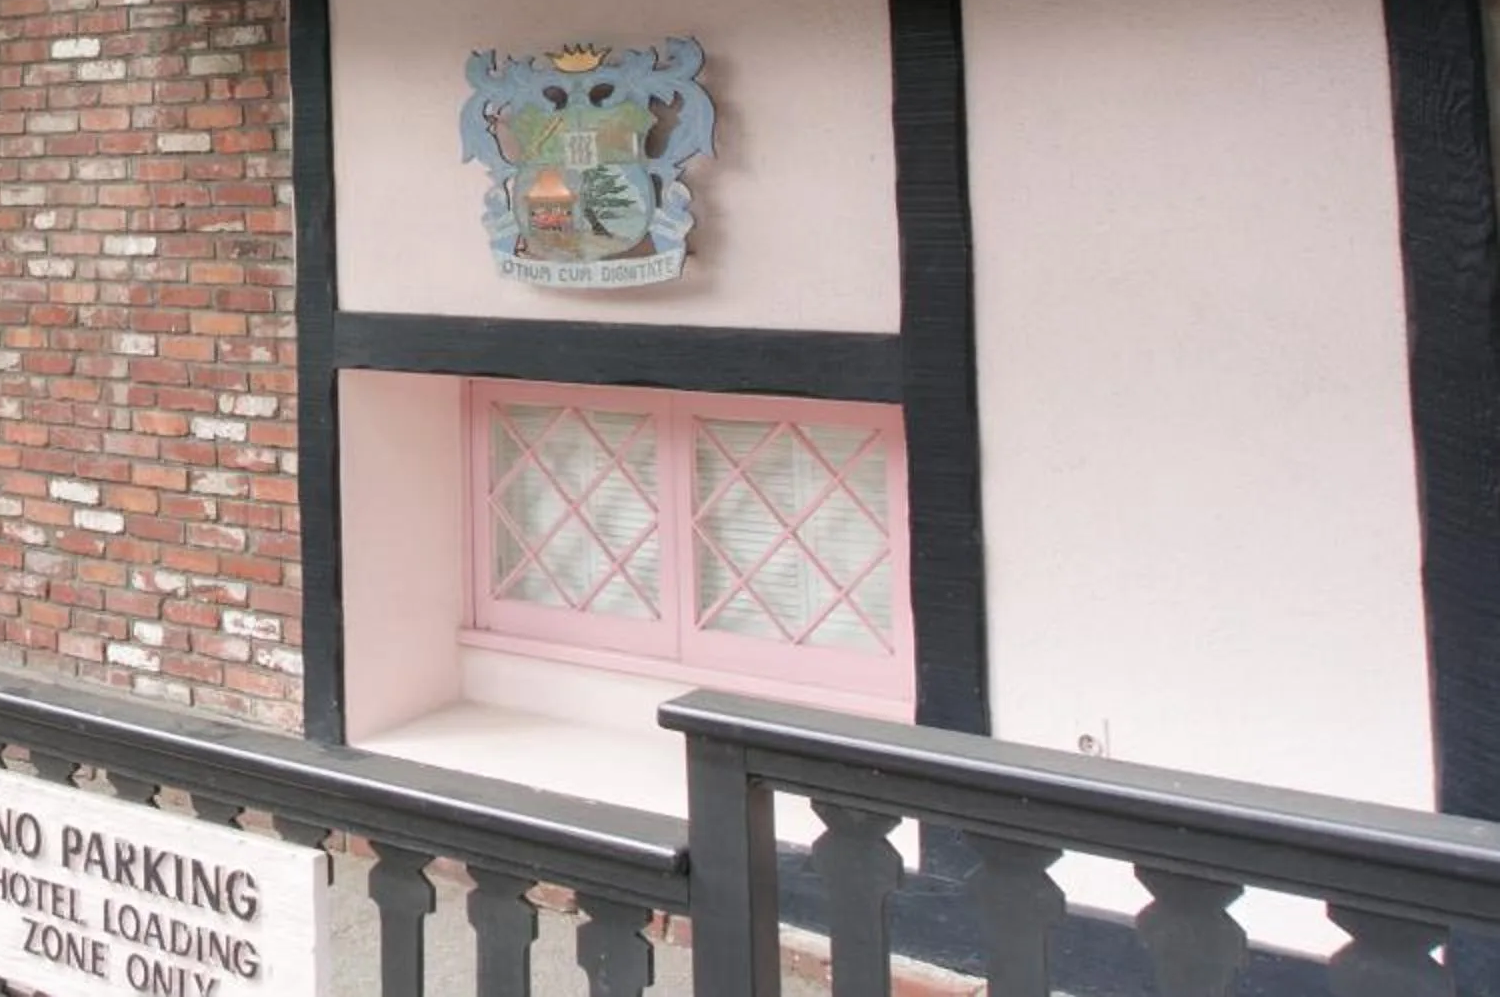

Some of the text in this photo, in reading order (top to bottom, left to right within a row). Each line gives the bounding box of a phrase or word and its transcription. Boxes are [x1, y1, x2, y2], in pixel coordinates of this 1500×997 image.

[61, 825, 258, 922] PARKING
[22, 917, 109, 978] ZONE
[104, 899, 260, 979] LOADING
